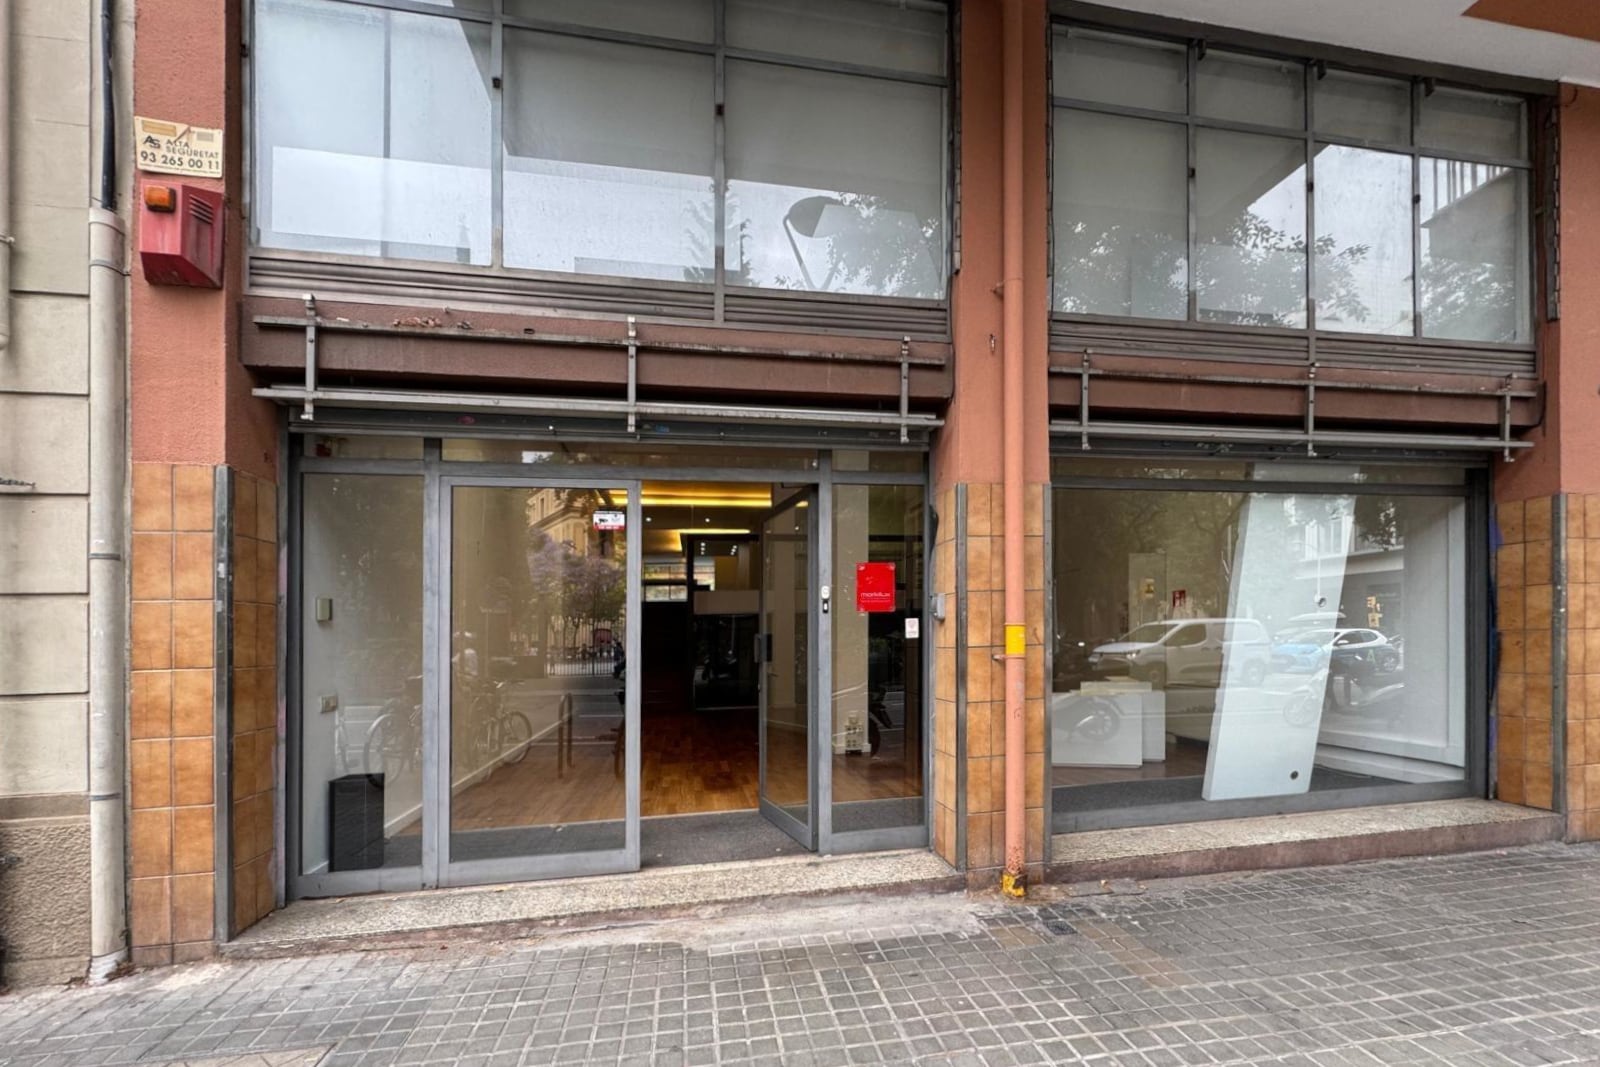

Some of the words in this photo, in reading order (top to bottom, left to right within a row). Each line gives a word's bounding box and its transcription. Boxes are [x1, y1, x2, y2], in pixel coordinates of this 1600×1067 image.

[167, 139, 189, 148] ALTA
[166, 146, 219, 158] SEGURETAT
[140, 151, 156, 163] 93
[161, 154, 184, 166] 265
[188, 158, 203, 169] 00
[208, 160, 219, 170] 11
